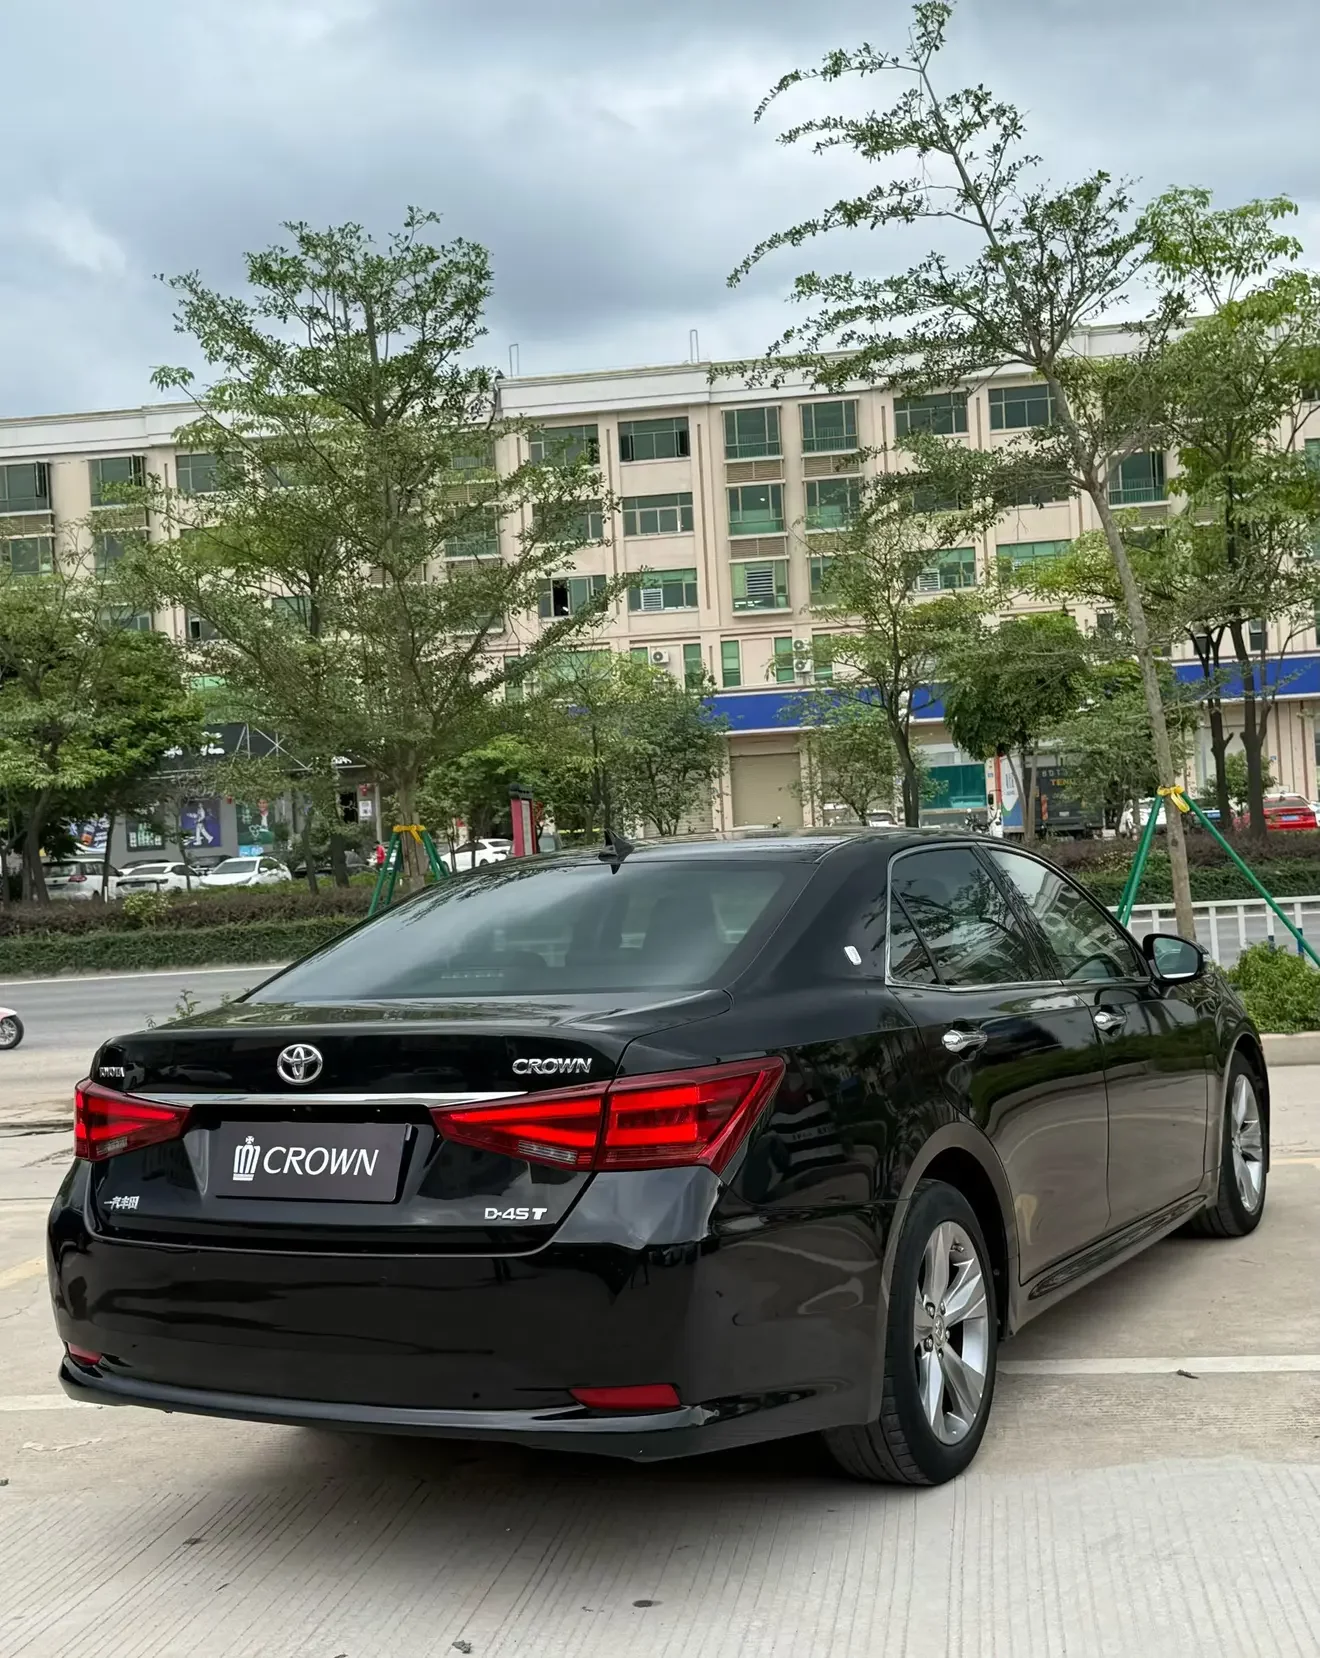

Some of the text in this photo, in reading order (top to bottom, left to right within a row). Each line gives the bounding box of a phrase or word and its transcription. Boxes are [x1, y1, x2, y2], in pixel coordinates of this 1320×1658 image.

[512, 1058, 592, 1074] CROWN
[263, 1146, 379, 1176] CROWN
[103, 1196, 140, 1210] 一汽丰田
